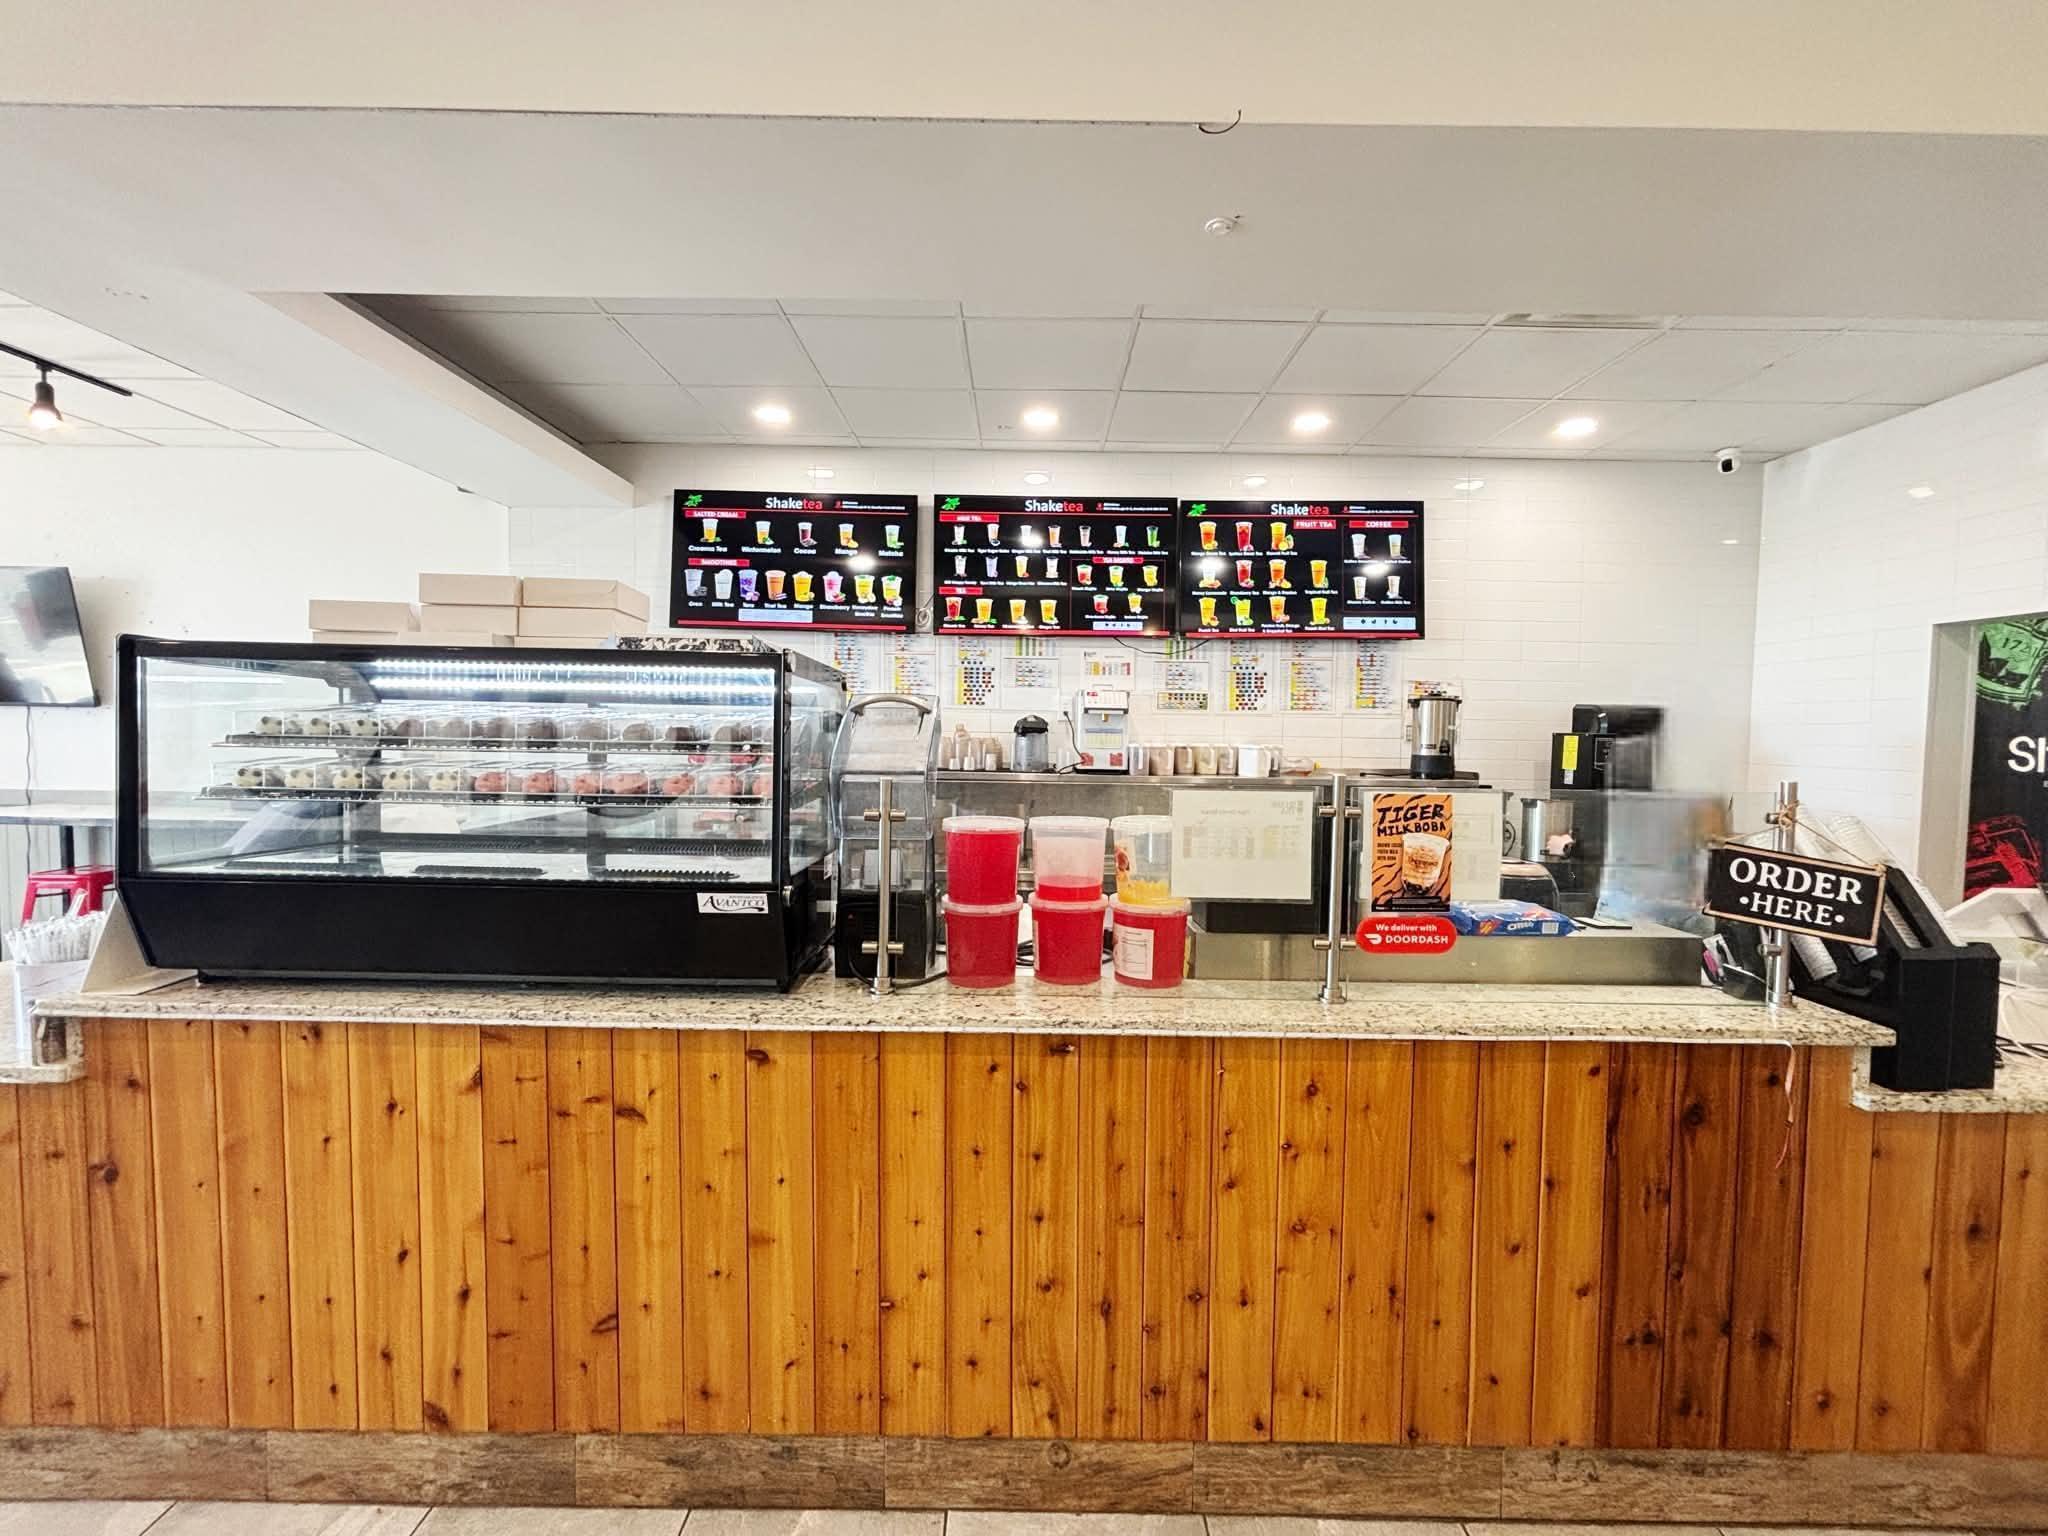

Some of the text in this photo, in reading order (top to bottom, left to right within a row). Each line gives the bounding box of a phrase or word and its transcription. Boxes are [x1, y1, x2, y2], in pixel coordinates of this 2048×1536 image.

[765, 496, 823, 510] Shaketea
[1024, 499, 1084, 512] Shaketea
[1270, 503, 1329, 515] Shaketea
[1377, 803, 1444, 825] TIGER
[1377, 821, 1446, 837] MILK BOBA
[1729, 857, 1863, 905] ORDER
[1750, 891, 1834, 926] HERE
[1375, 923, 1437, 932] We deliver with
[1385, 935, 1449, 944] DOORDASH
